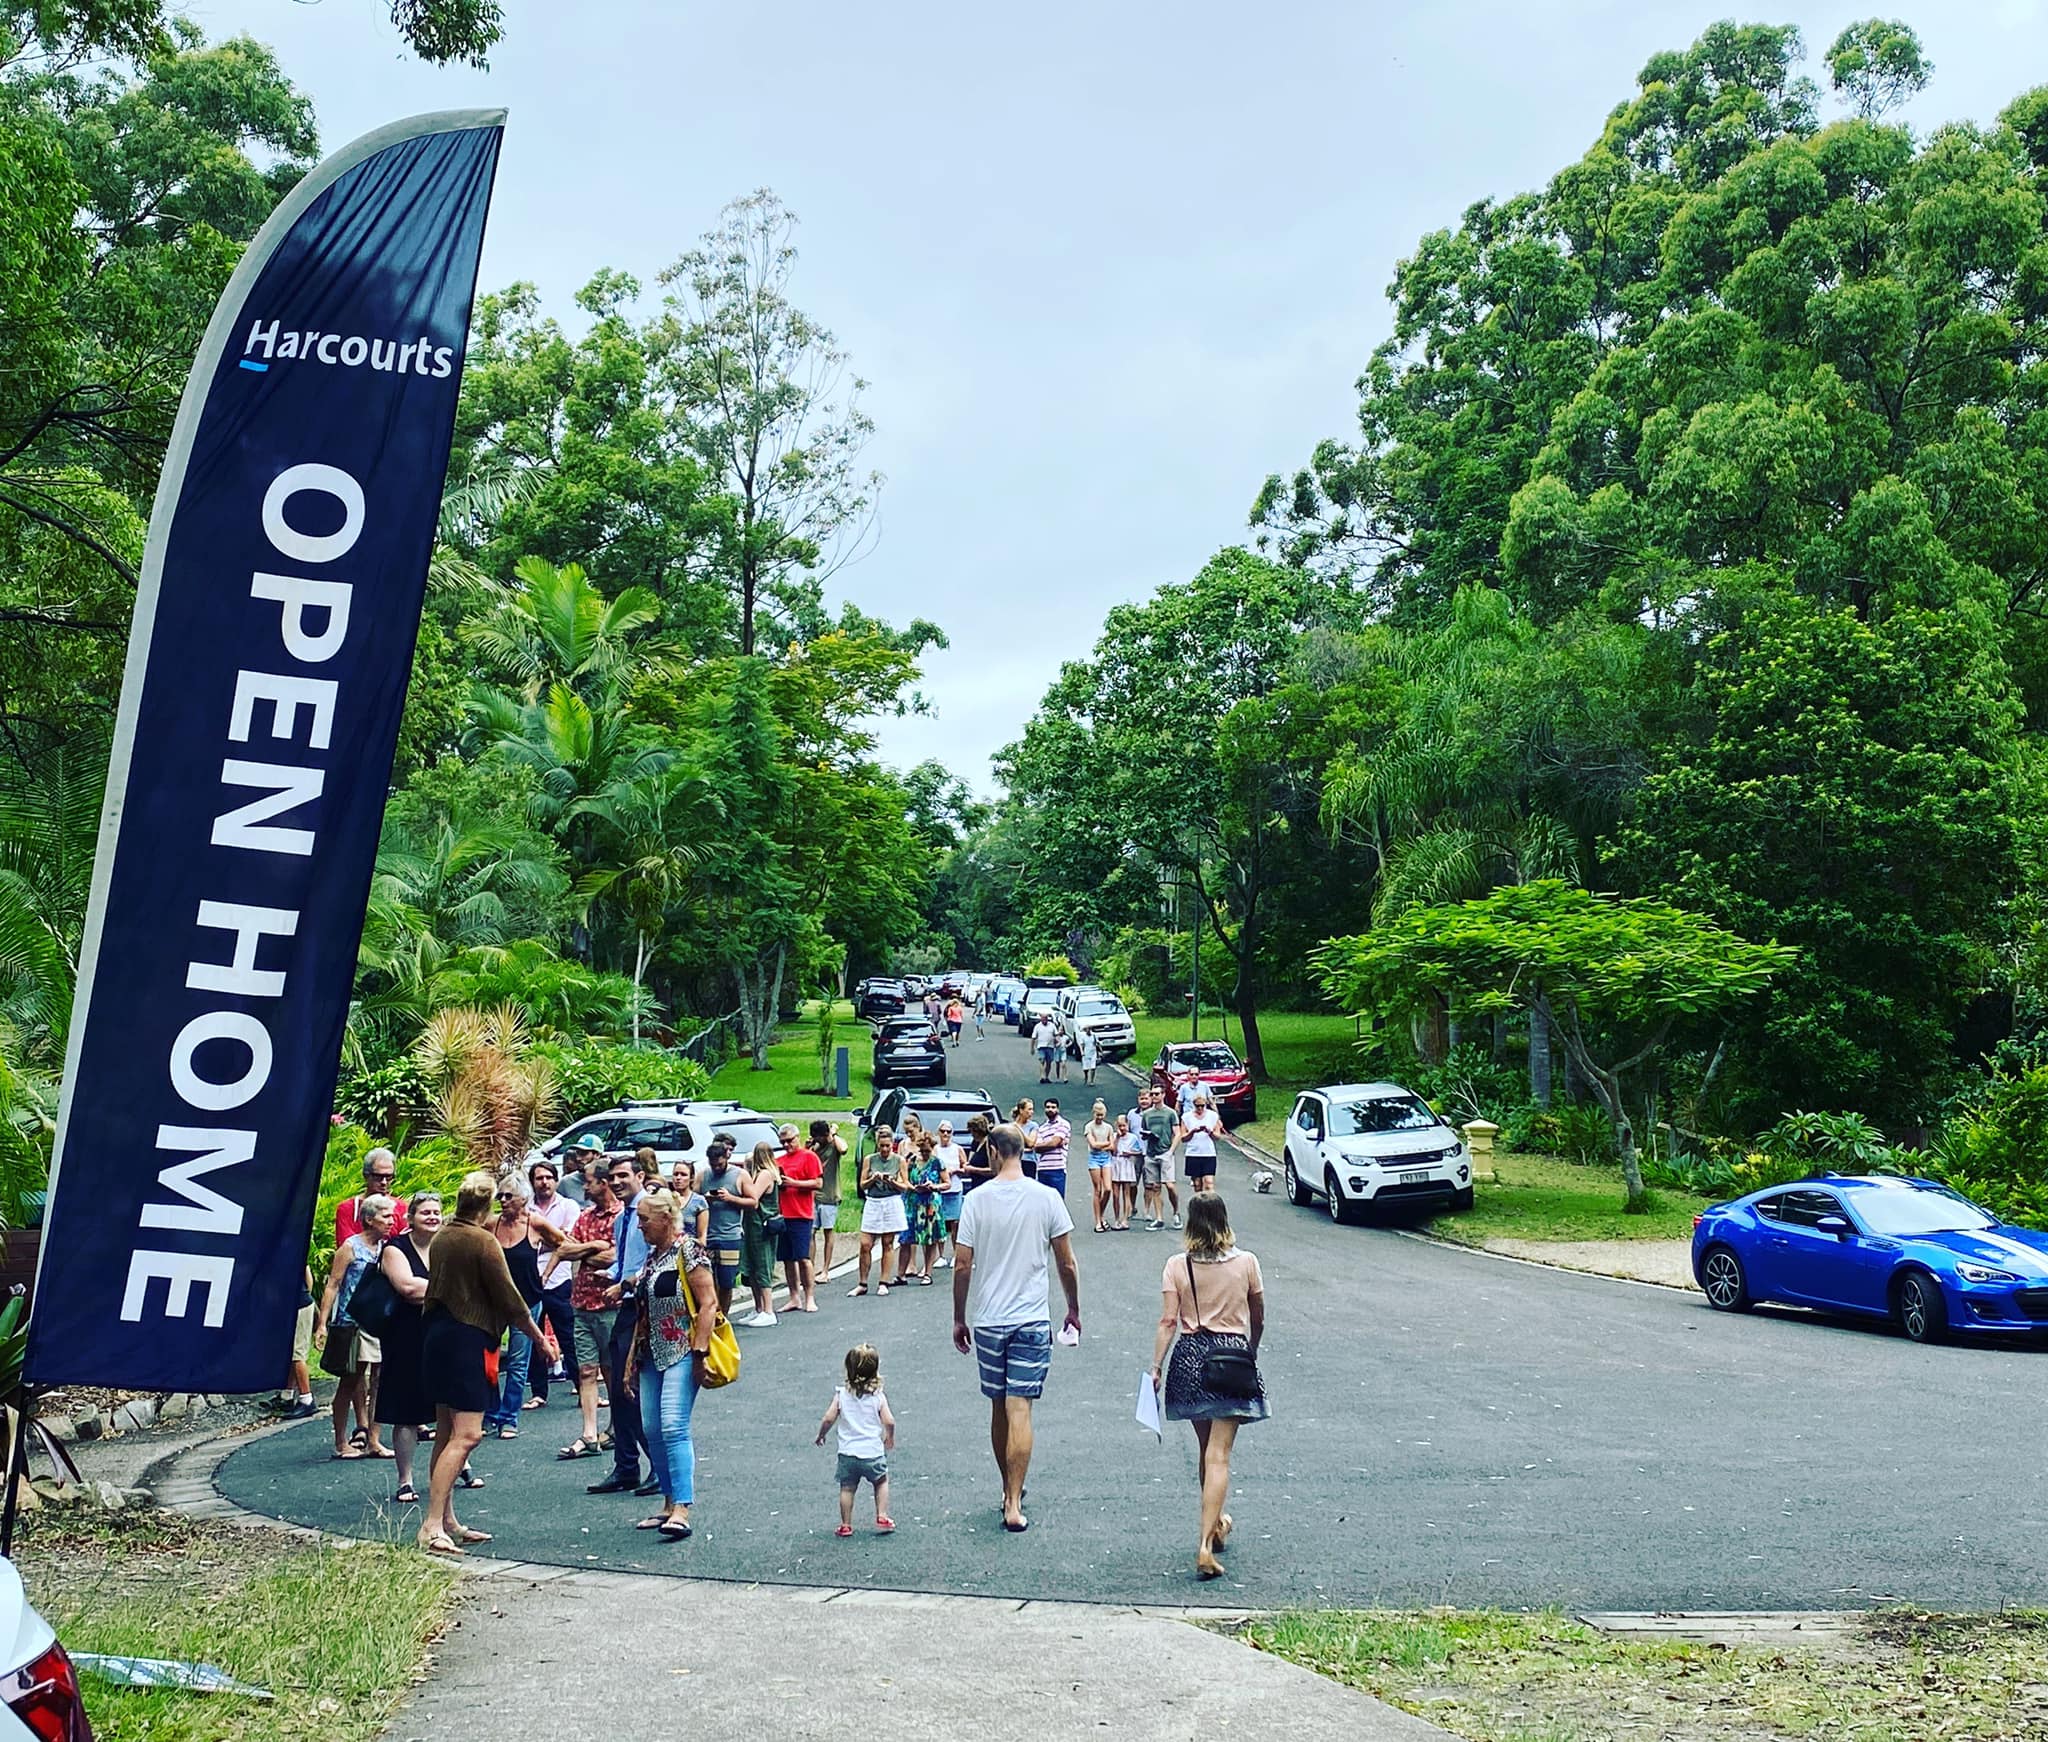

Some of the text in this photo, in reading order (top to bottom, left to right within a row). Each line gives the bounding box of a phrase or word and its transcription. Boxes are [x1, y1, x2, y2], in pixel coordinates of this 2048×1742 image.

[245, 318, 454, 379] Harcourts
[120, 463, 366, 1328] OPEN HOME
